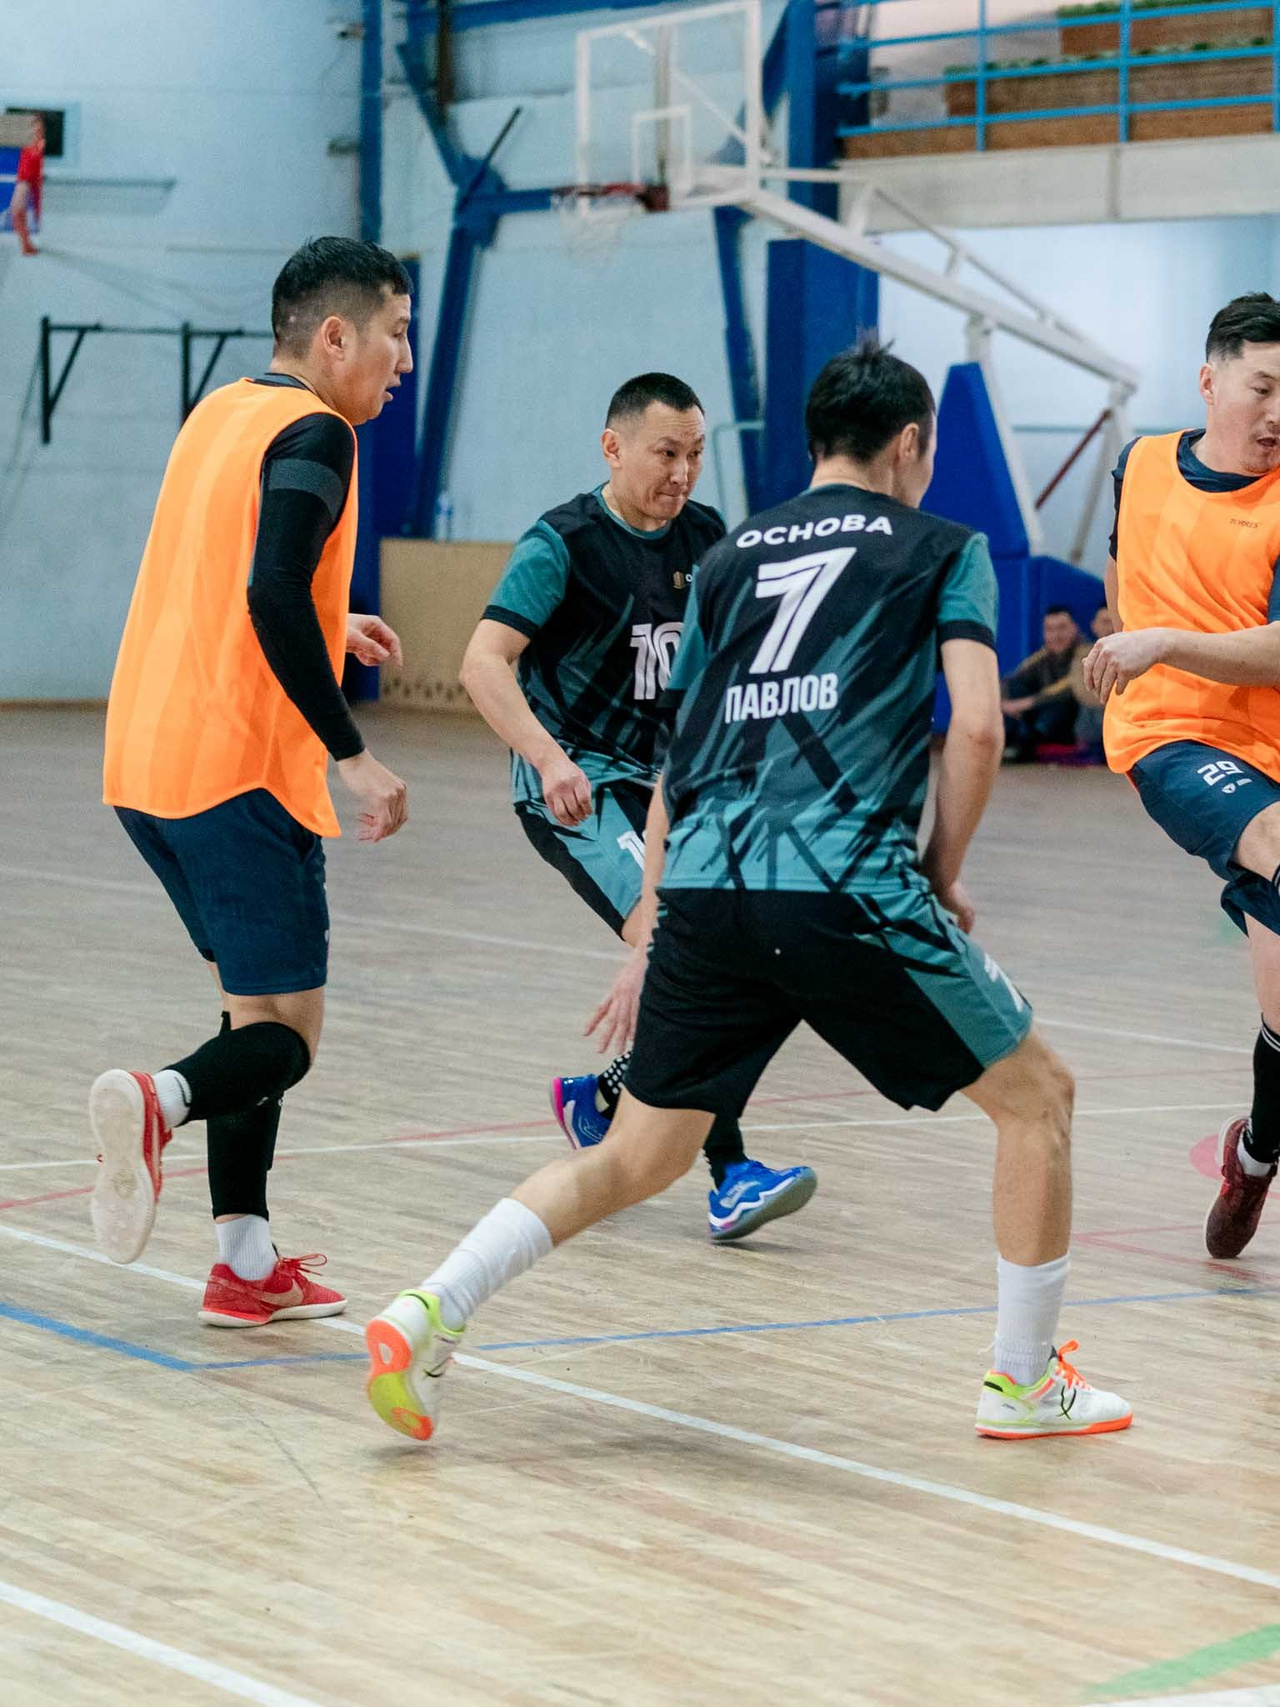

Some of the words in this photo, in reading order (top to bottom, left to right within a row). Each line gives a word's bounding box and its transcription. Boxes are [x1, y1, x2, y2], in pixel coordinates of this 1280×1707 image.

[736, 514, 893, 549] ОСНОВА
[749, 547, 857, 674] 7
[724, 672, 839, 724] ПАВЛОВ
